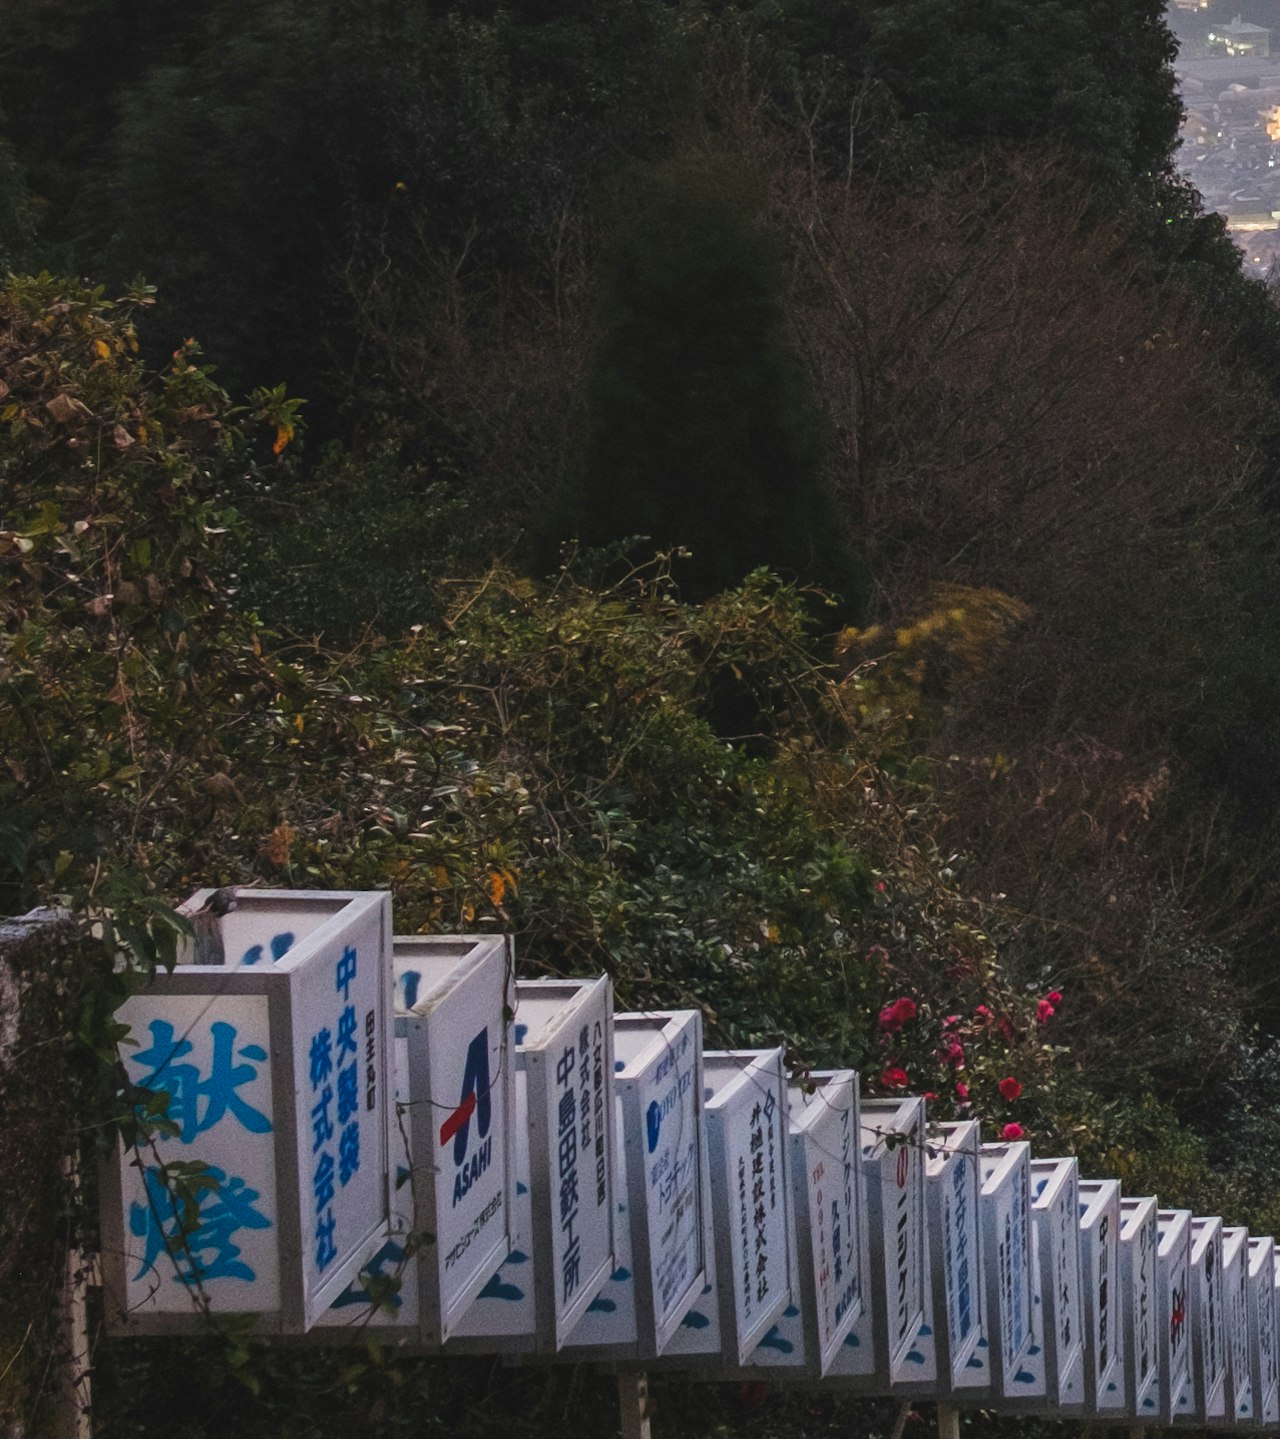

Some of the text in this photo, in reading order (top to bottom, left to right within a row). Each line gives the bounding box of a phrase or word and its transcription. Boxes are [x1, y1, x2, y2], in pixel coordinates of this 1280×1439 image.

[309, 1027, 337, 1273] 株式会社
[336, 945, 360, 1186] 中央製袋
[579, 1024, 591, 1150] 株式会社
[453, 1135, 491, 1208] ASAHI
[557, 1047, 580, 1303] 中島田鉄工所
[831, 1199, 842, 1283] 久留米
